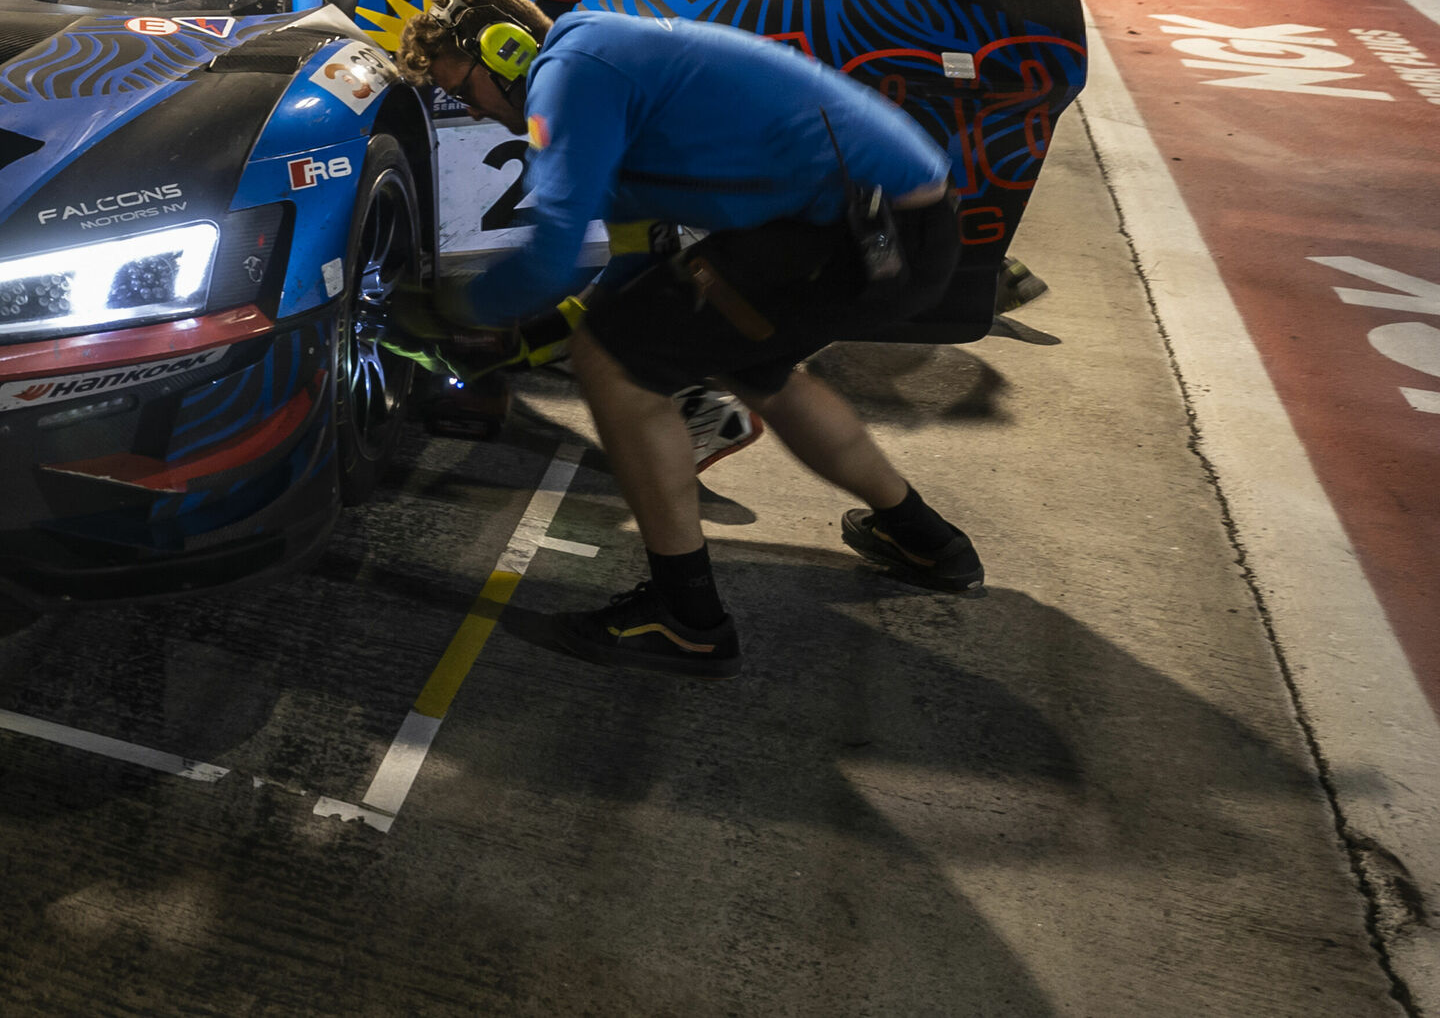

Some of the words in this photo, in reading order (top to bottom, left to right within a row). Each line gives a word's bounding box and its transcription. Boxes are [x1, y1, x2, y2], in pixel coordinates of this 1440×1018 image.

[1148, 13, 1396, 102] NGK
[304, 156, 353, 182] R8
[481, 139, 538, 232] 2
[37, 182, 183, 225] FALCONS
[80, 207, 160, 230] MOTORS
[163, 201, 187, 214] NV
